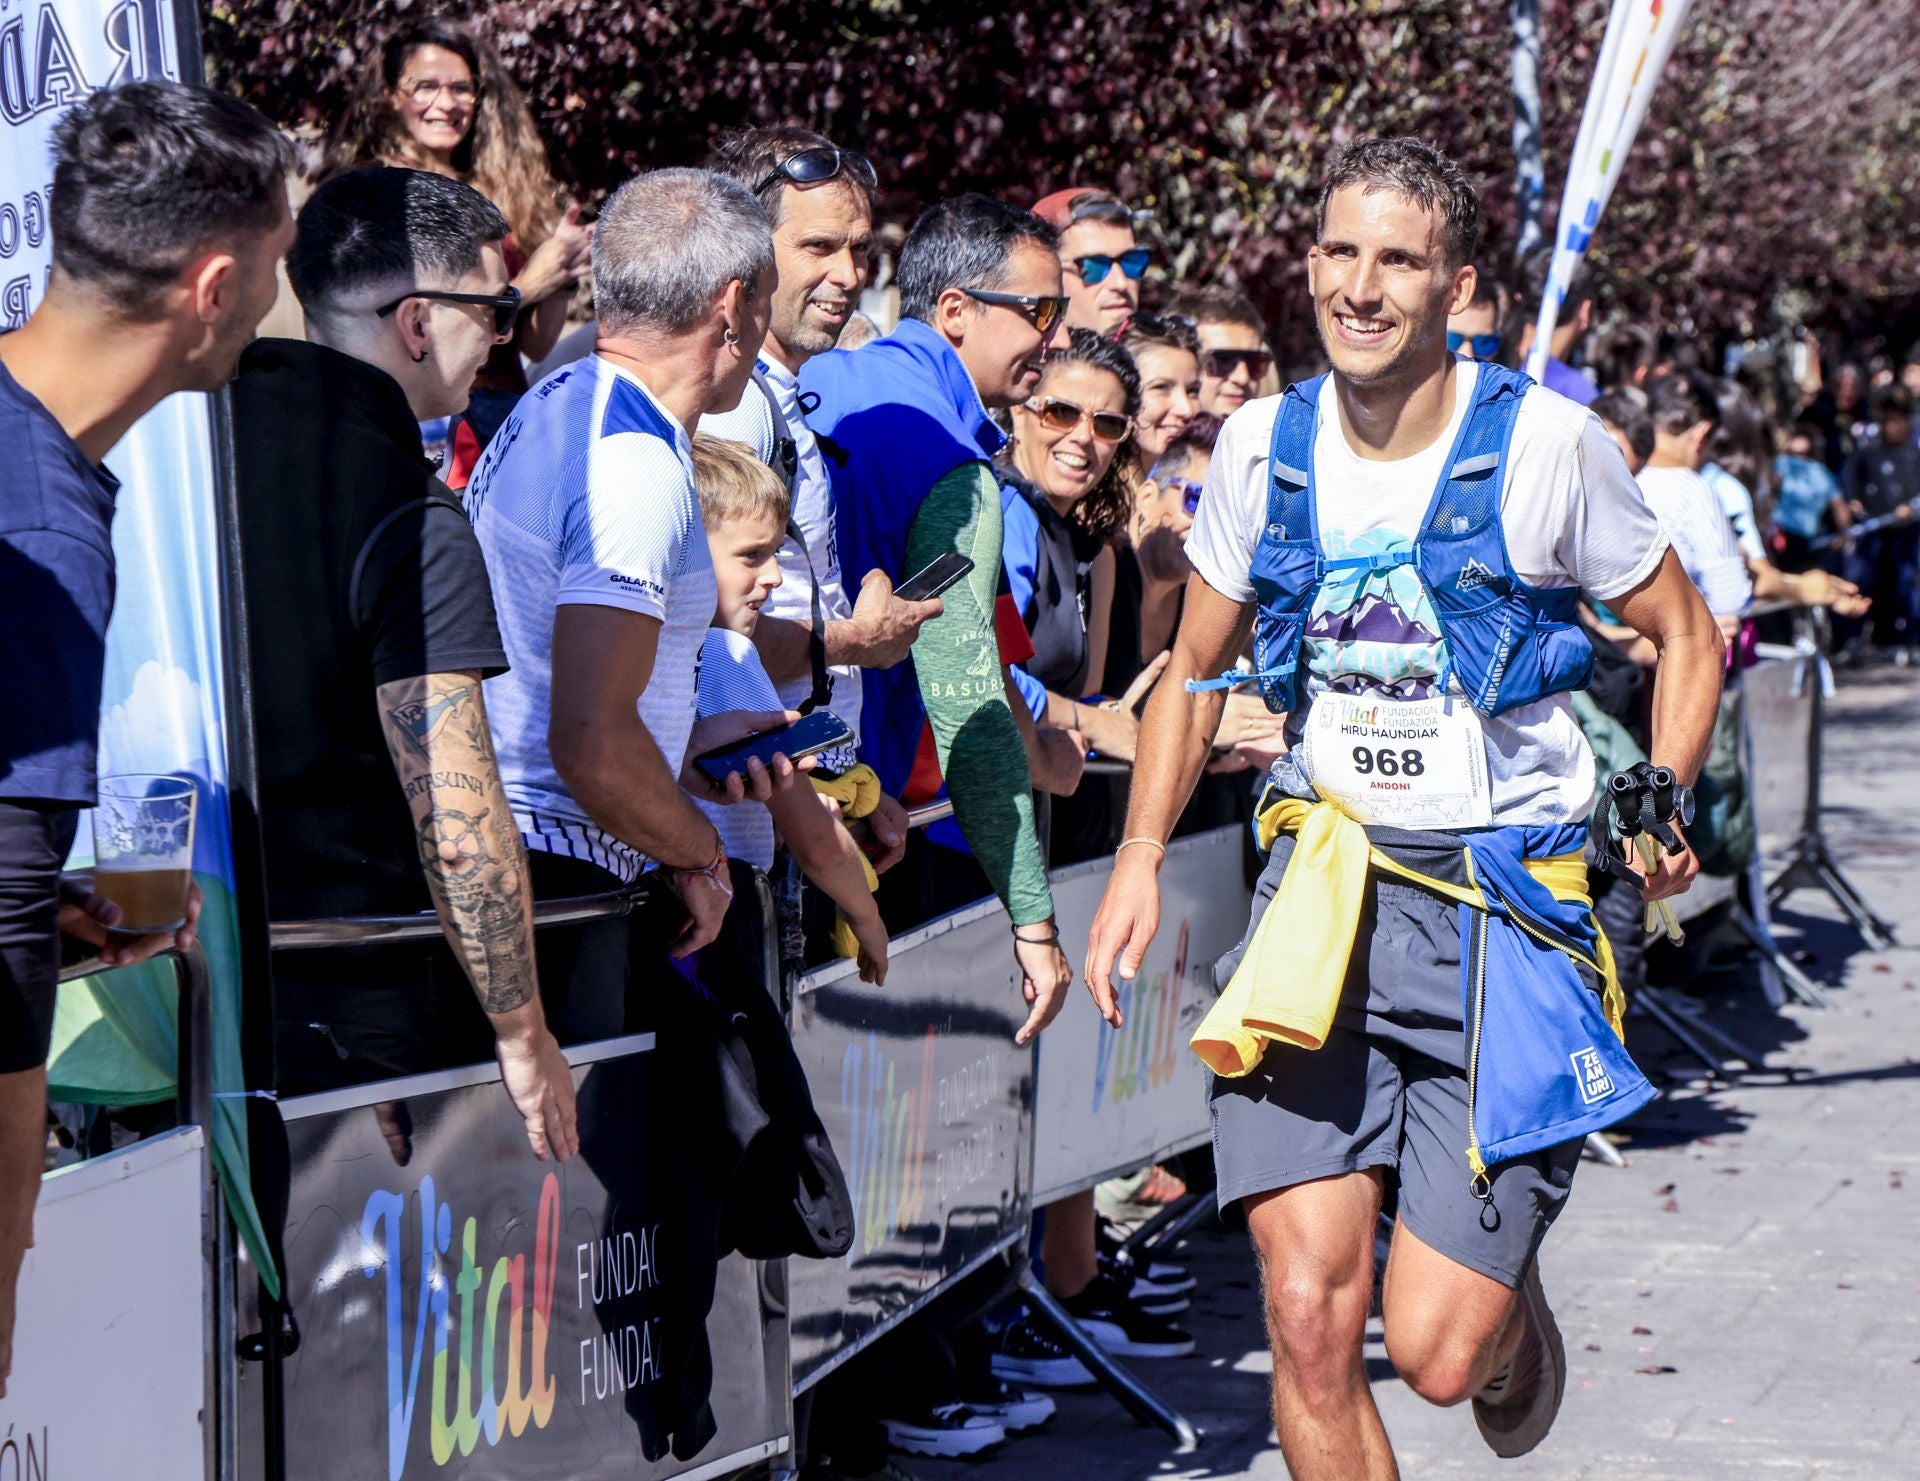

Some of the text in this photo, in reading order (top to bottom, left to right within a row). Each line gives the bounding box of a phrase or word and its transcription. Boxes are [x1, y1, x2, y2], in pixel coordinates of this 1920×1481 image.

[609, 574, 648, 587] GALAR
[1340, 699, 1379, 725] Vital
[1341, 723, 1440, 739] HIRU HAUNDIAK
[1383, 717, 1439, 729] FUNDAZIOA
[1352, 746, 1425, 777] 968
[1370, 781, 1411, 790] ANDONI
[1581, 1051, 1600, 1069] ZE
[1586, 1063, 1605, 1083] AN
[1586, 1076, 1610, 1096] URI
[361, 1172, 559, 1481] Vital
